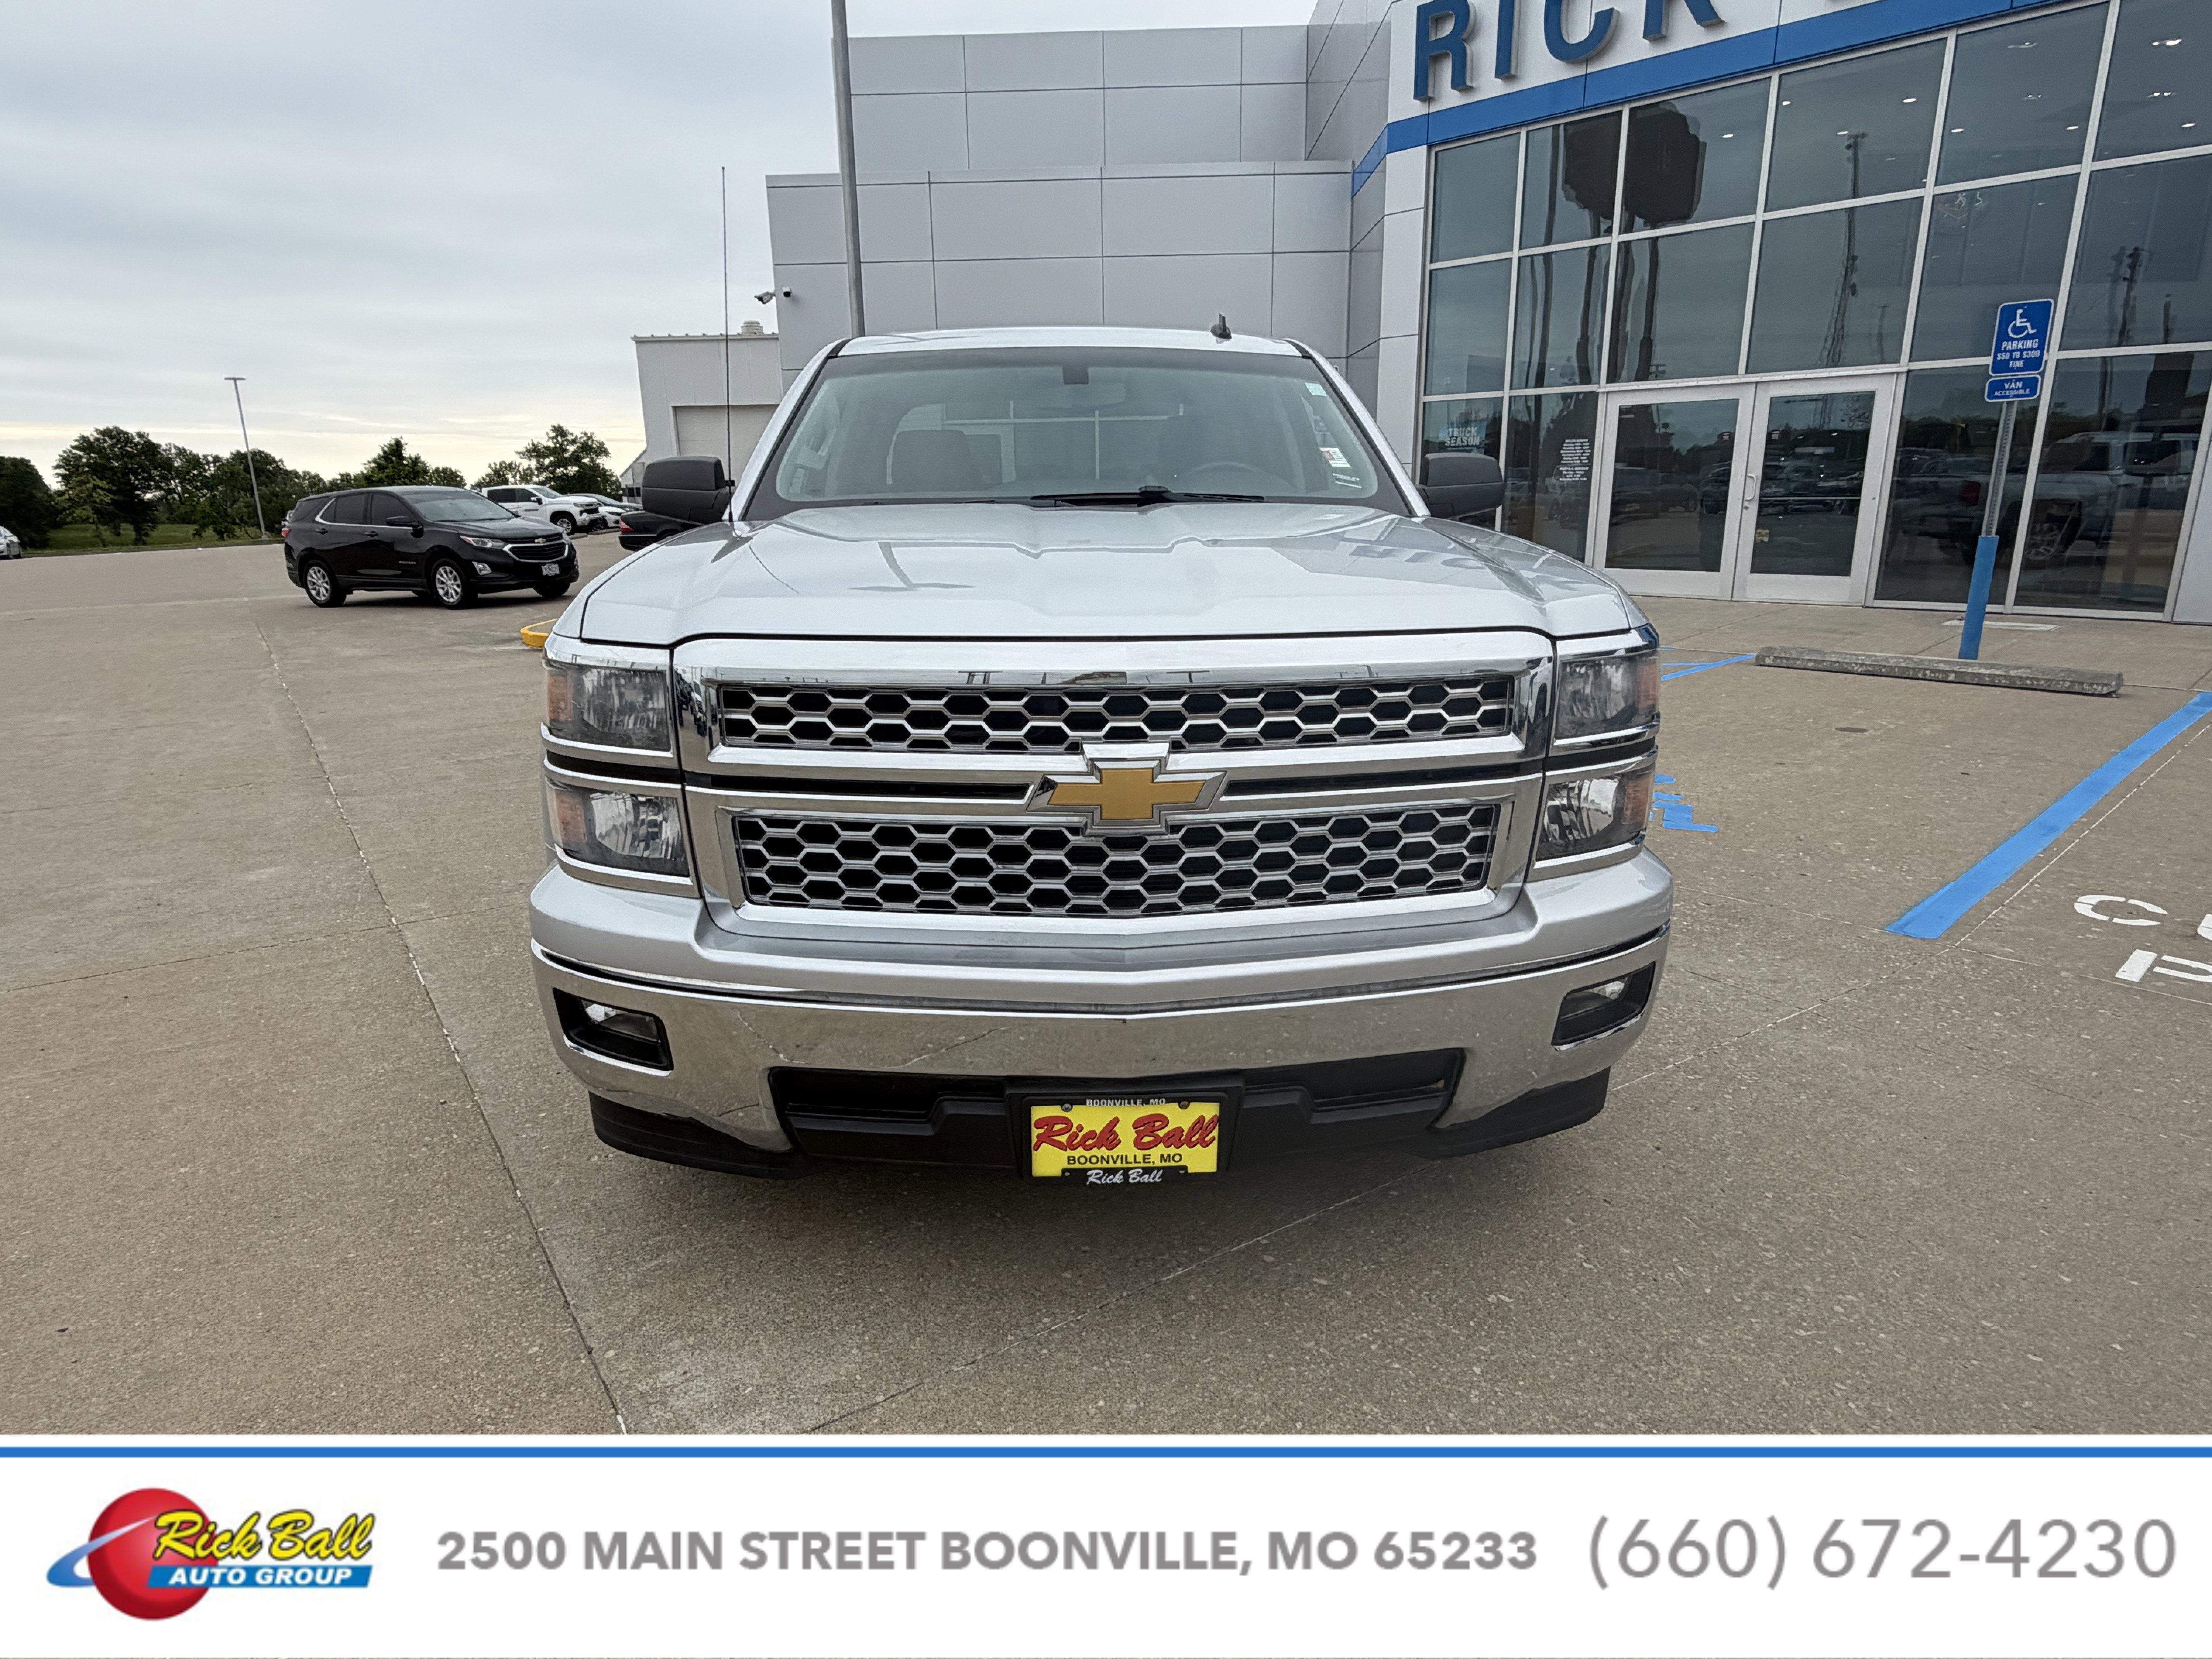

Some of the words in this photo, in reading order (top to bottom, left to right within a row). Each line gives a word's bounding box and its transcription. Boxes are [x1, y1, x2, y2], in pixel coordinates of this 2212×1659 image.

[2001, 338, 2039, 351] PARKING
[1448, 426, 1478, 437] TRUCK
[1444, 436, 1480, 446] SEASON
[1149, 1098, 1166, 1106] MO
[1032, 1115, 1122, 1152] Rick
[1132, 1113, 1219, 1151] Ball
[1066, 1154, 1156, 1166] BOONVILLE,
[1159, 1152, 1183, 1163] MO
[1086, 1170, 1124, 1185] Rick
[1128, 1168, 1163, 1183] Ball
